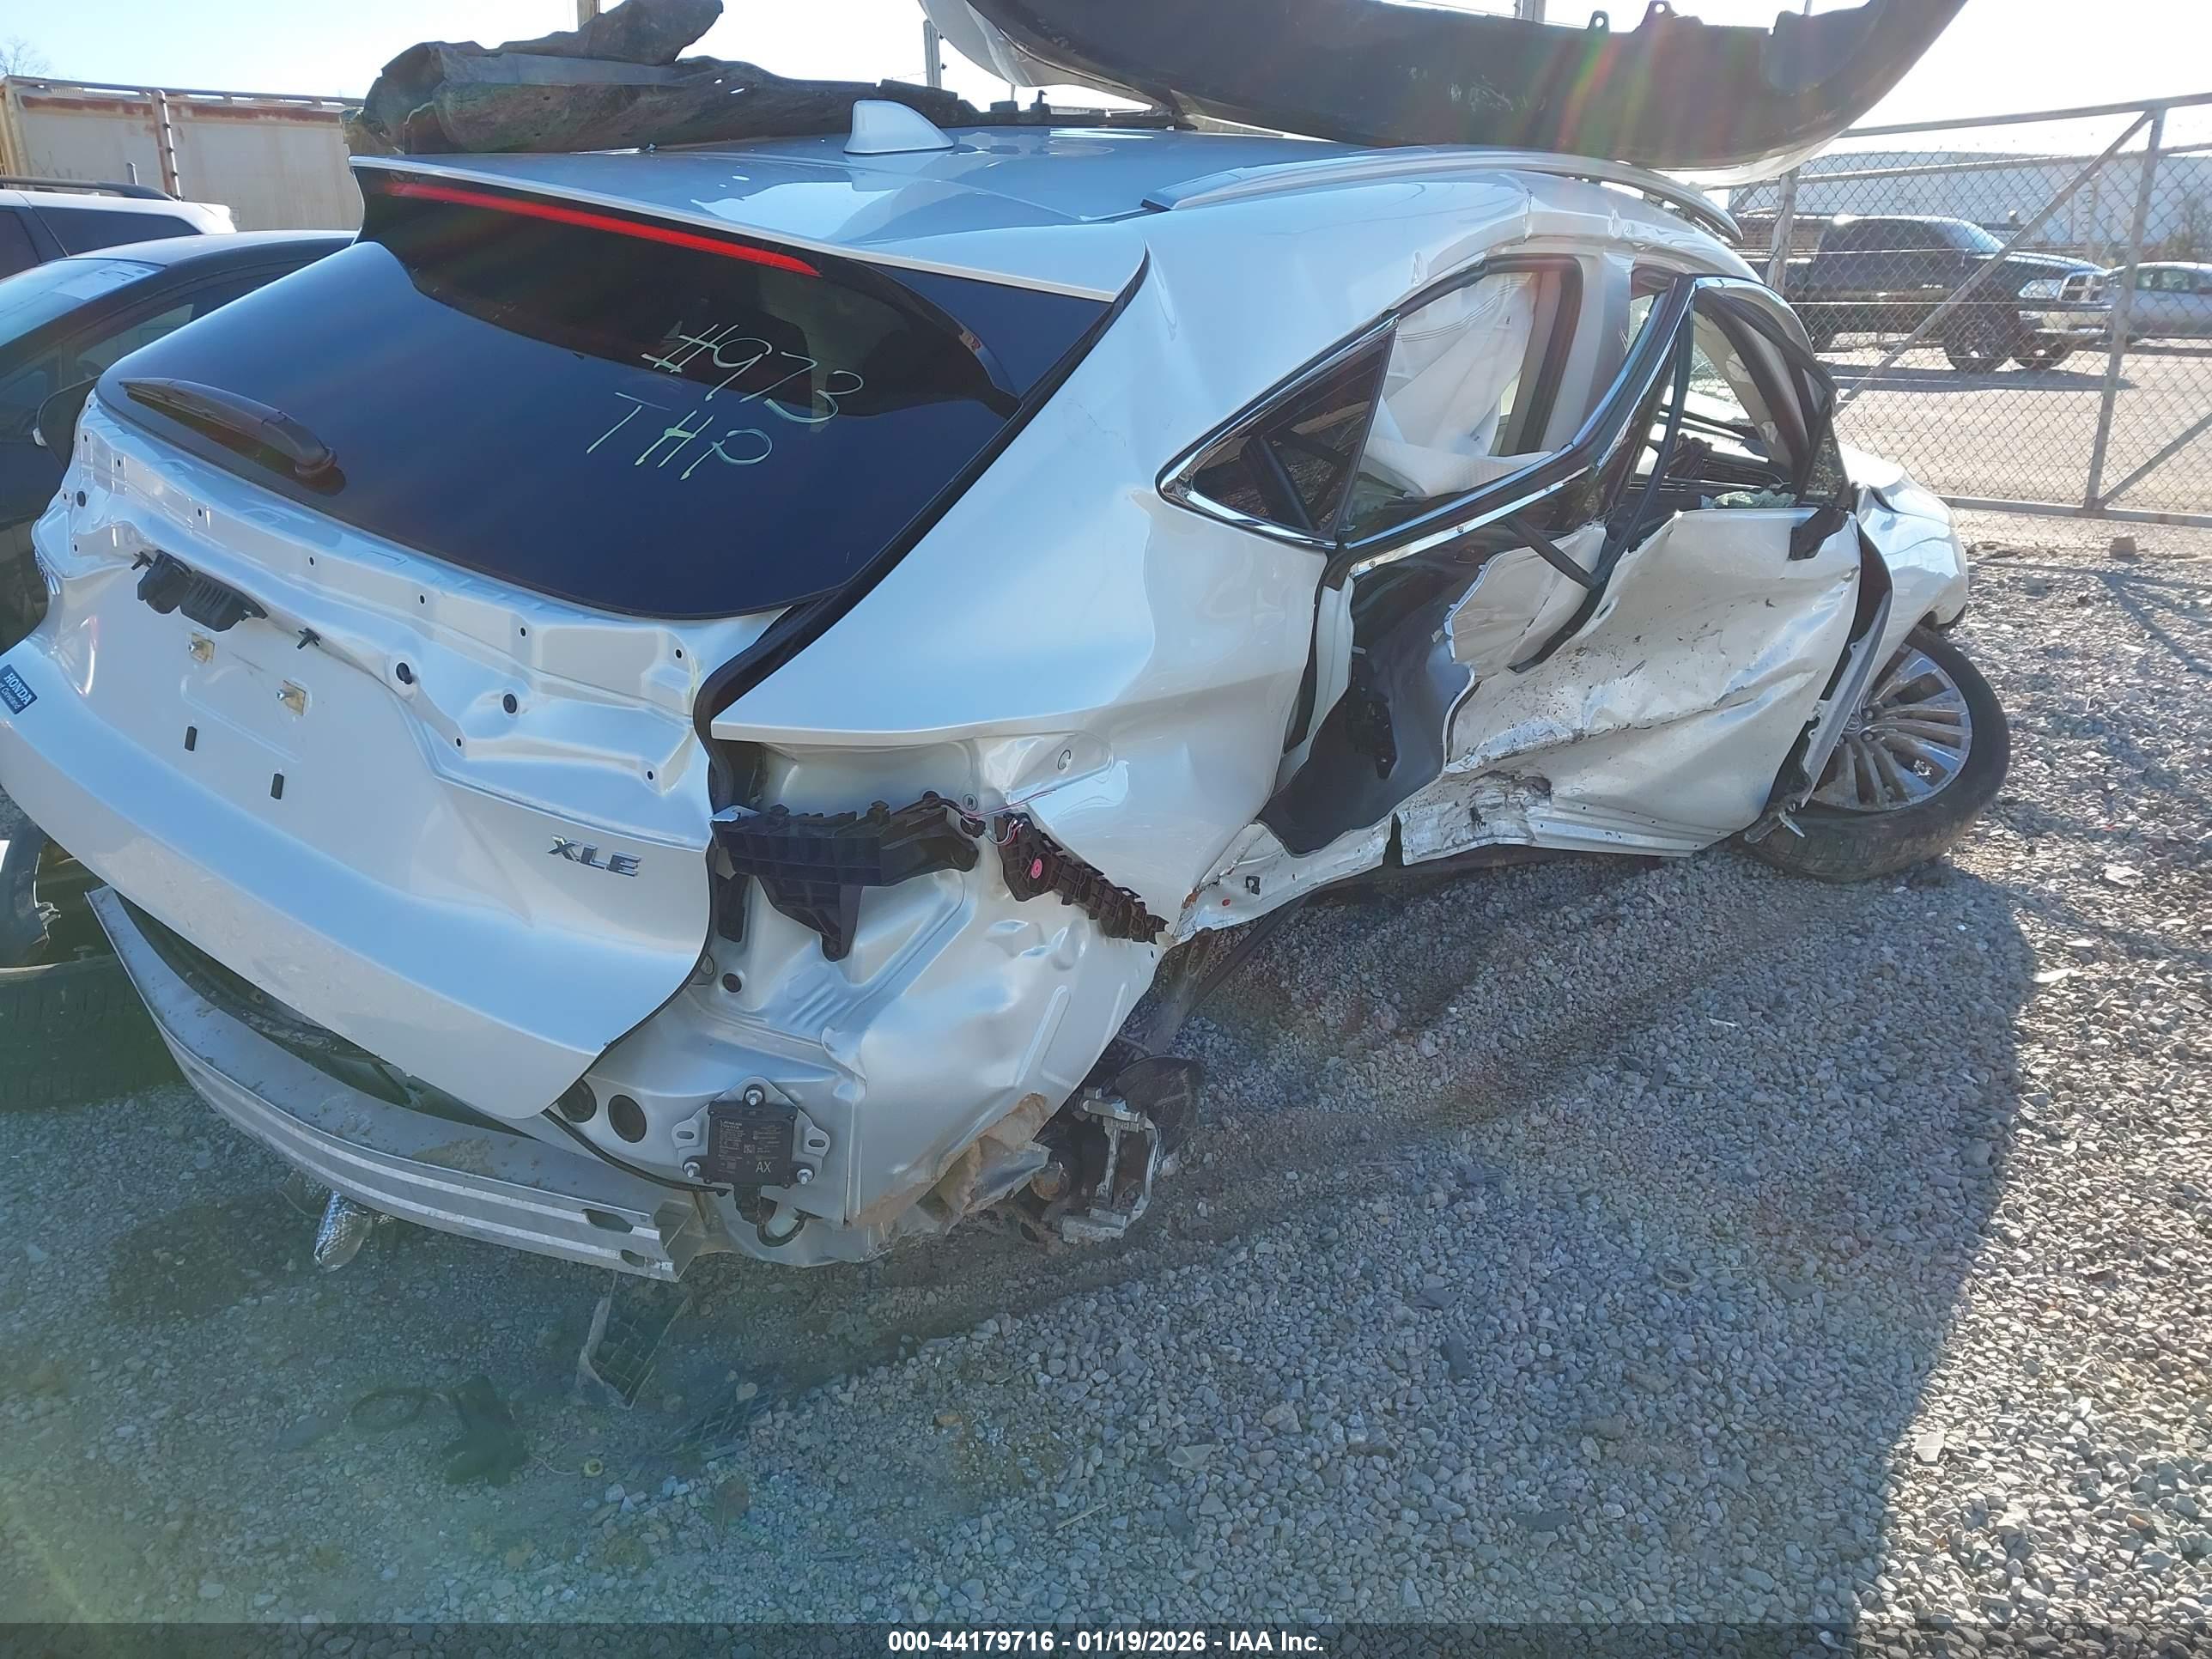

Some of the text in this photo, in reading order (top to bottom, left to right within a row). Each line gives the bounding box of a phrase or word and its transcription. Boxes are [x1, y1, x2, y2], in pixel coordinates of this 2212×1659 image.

[641, 324, 864, 423] #973
[3, 672, 33, 706] HONDA
[548, 833, 642, 878] XLE
[756, 1161, 772, 1174] AX
